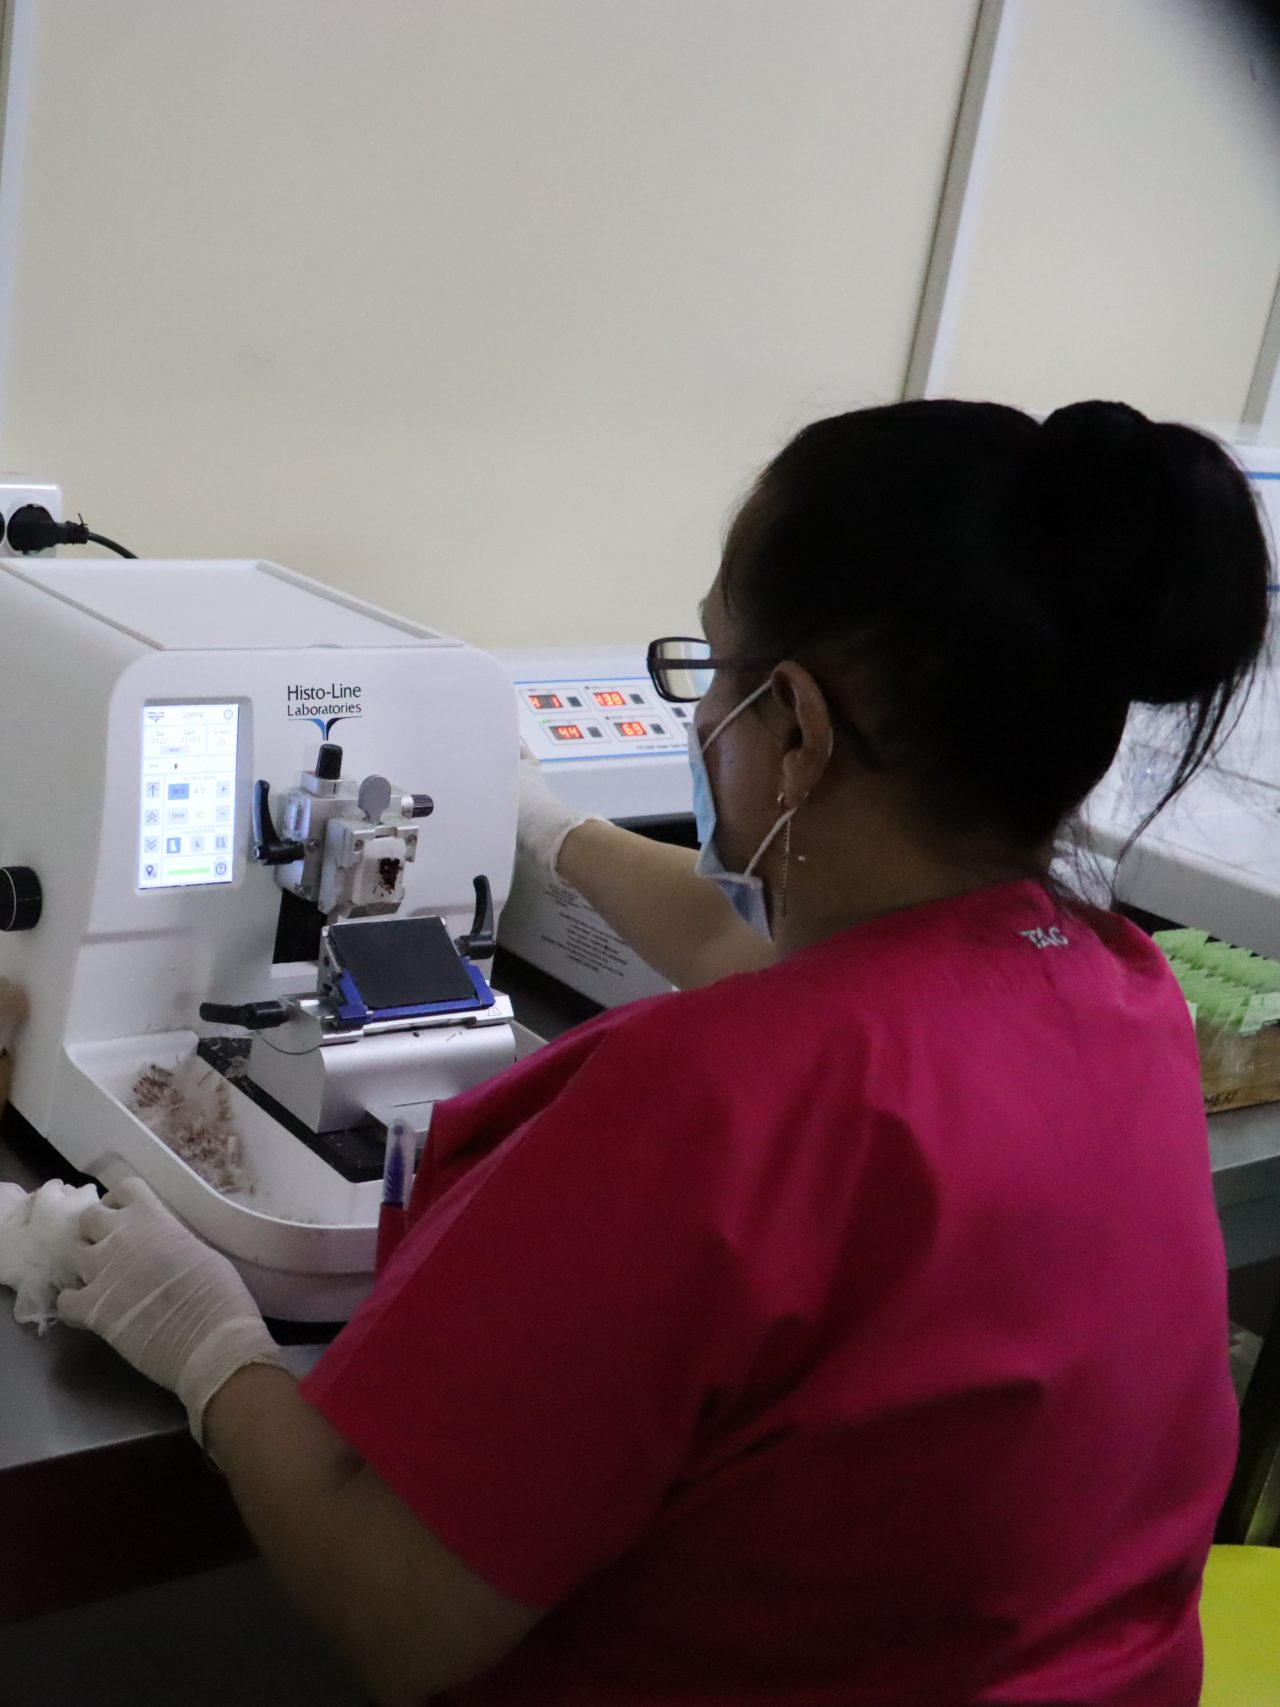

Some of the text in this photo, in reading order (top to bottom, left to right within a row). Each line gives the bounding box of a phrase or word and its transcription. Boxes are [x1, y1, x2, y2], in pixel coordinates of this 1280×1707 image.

[287, 683, 362, 701] Histo-Line
[287, 702, 362, 716] Laboratories
[557, 726, 582, 739] 44
[621, 722, 644, 737] 69
